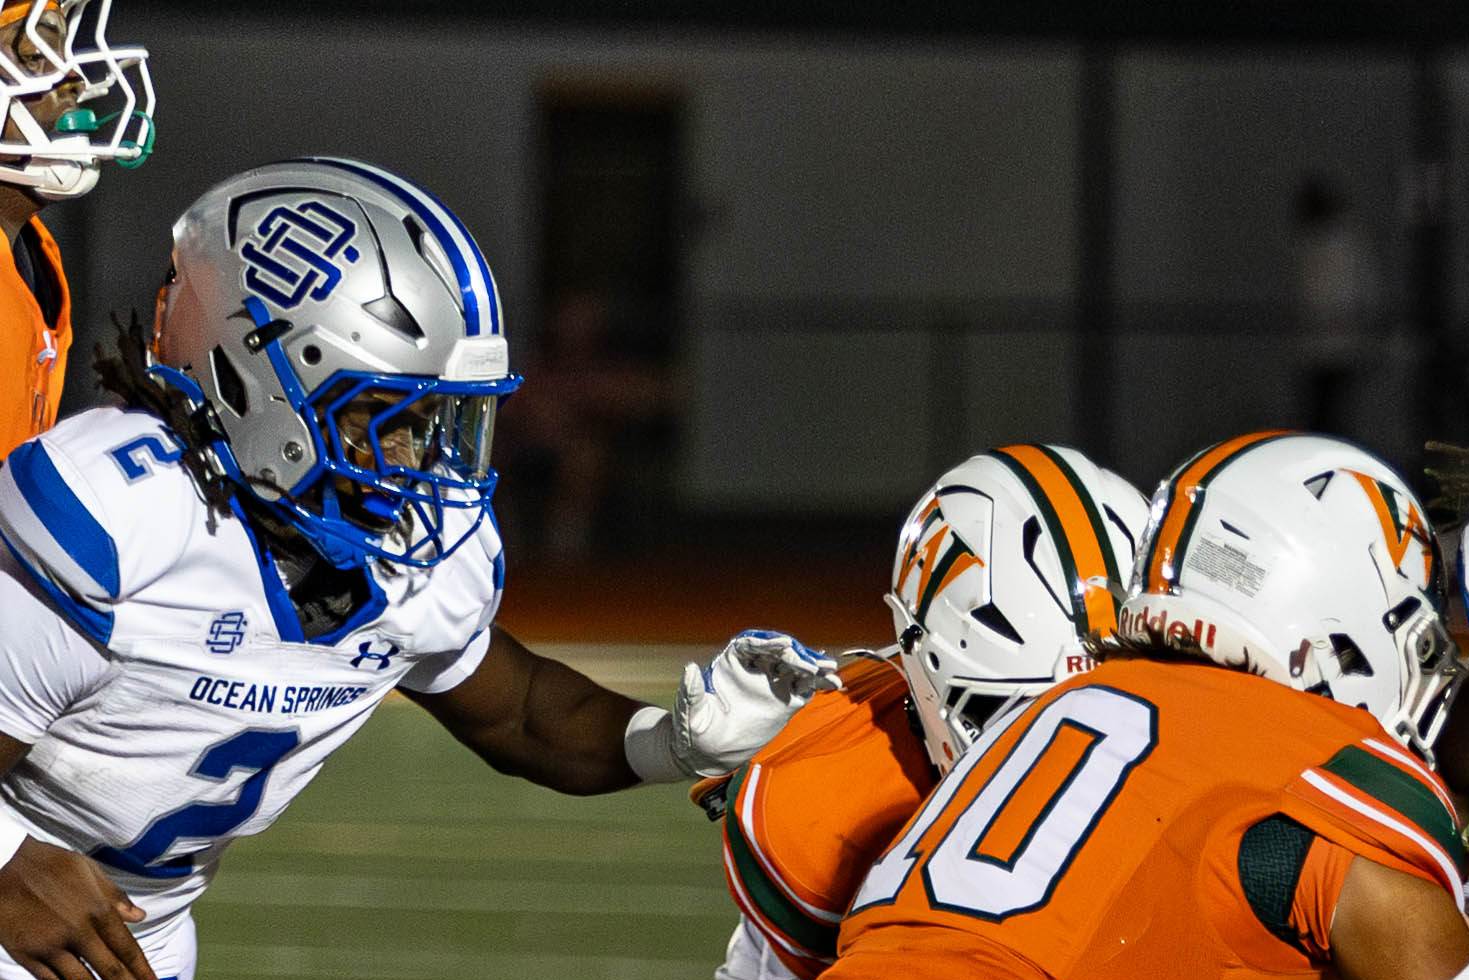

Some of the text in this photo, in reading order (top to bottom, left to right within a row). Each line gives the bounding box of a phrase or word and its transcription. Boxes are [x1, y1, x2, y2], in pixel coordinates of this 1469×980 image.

[105, 433, 183, 486] 2
[189, 676, 368, 714] OCEAN SPRINGS
[86, 726, 301, 879] 2
[848, 684, 1160, 924] 10
